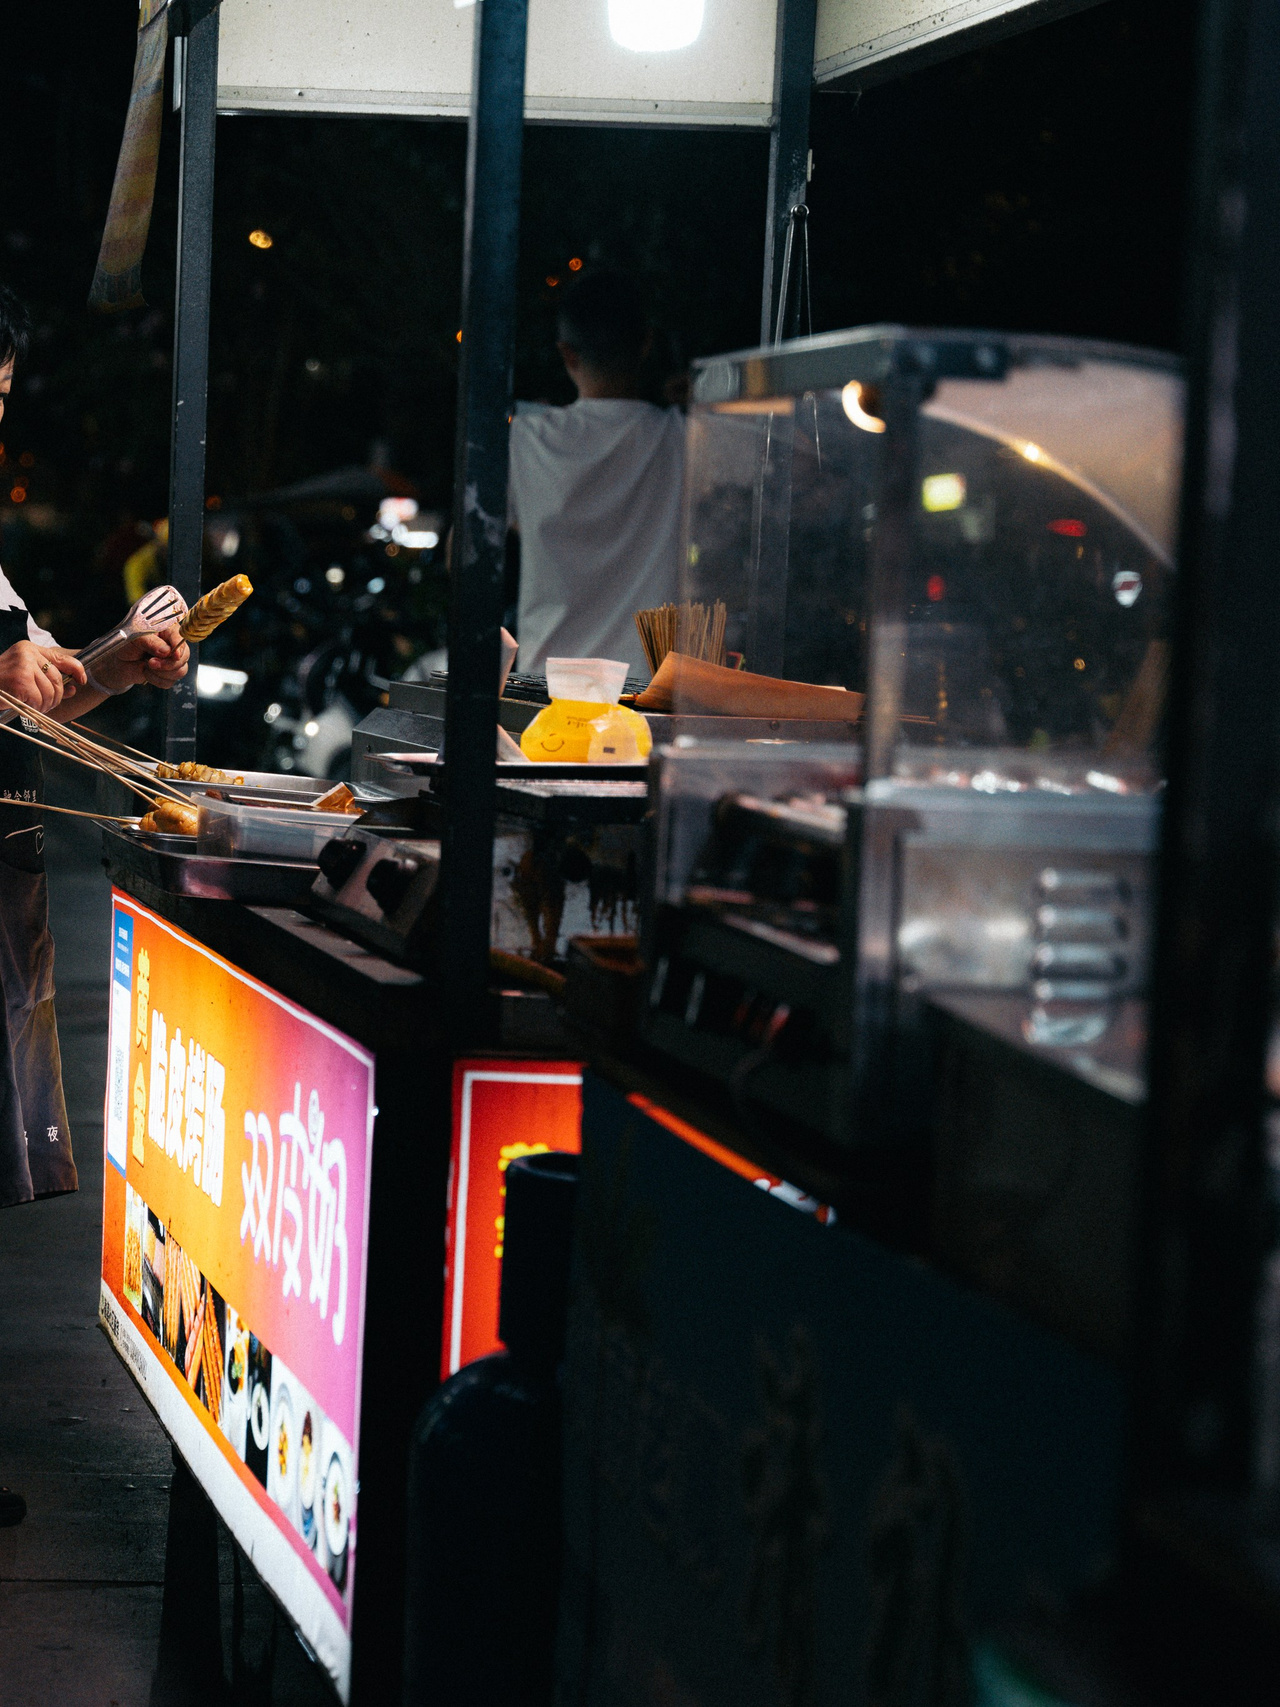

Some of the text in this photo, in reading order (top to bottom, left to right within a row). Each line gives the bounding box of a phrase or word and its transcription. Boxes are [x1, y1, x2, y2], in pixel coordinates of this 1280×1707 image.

[148, 1008, 226, 1208] 脆皮烤肠
[239, 1081, 349, 1346] 双皮奶
